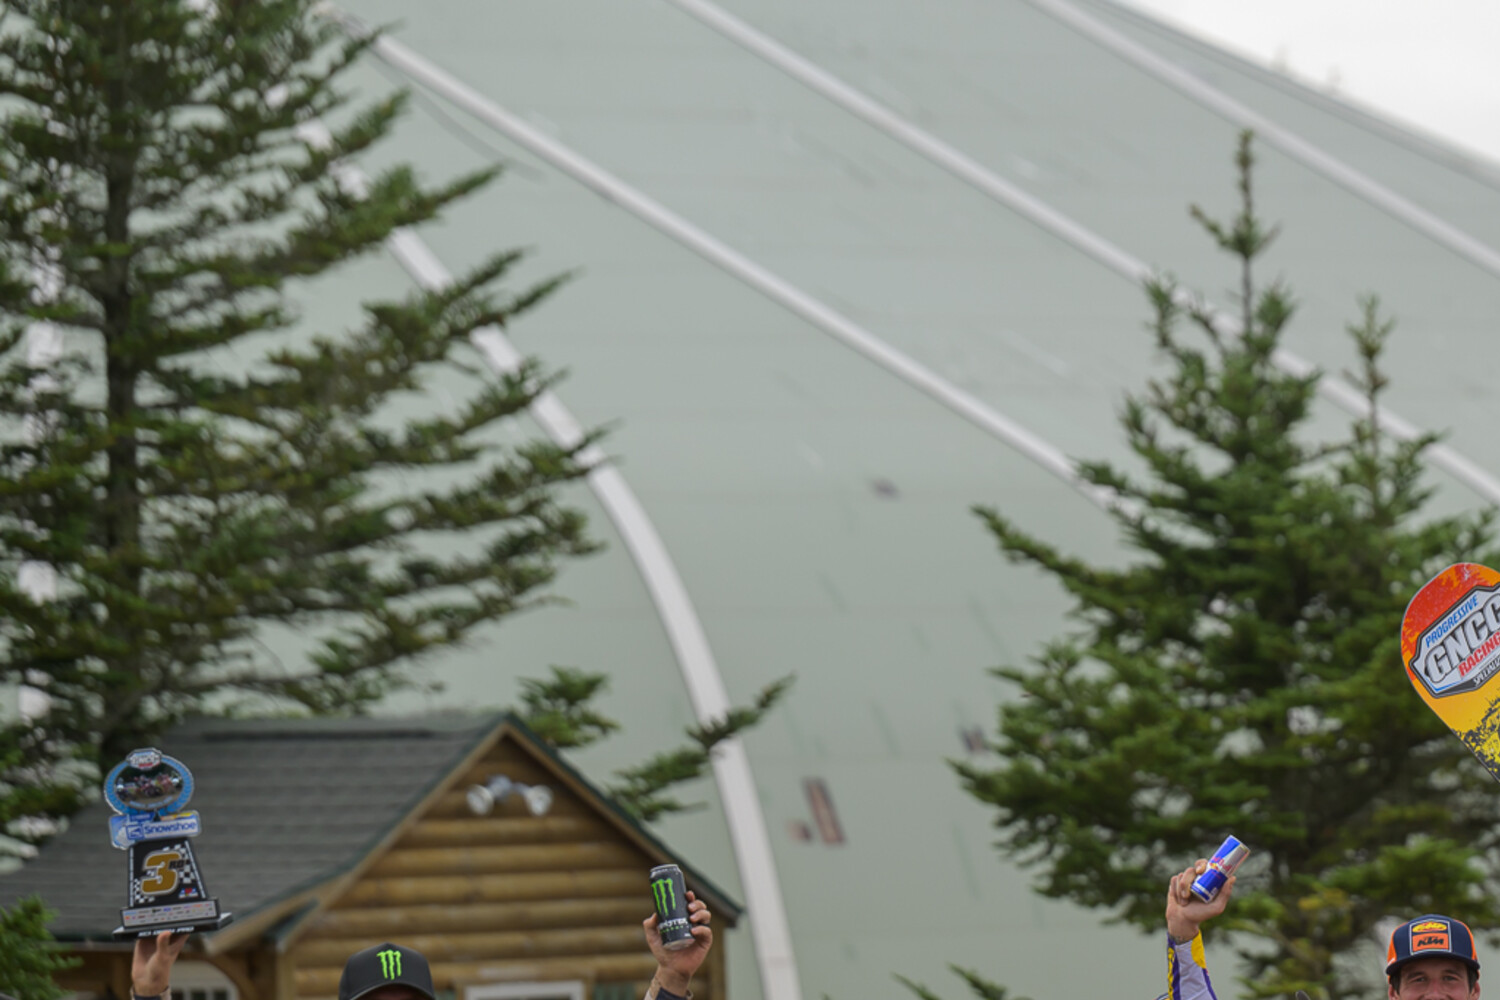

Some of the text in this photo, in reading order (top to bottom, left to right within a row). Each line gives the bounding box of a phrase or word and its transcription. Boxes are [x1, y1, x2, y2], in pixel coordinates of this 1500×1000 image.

[1425, 594, 1479, 648] PROGRESSIVE
[144, 820, 197, 835] Snowshoe
[141, 850, 183, 896] 3
[1417, 935, 1444, 947] KTM
